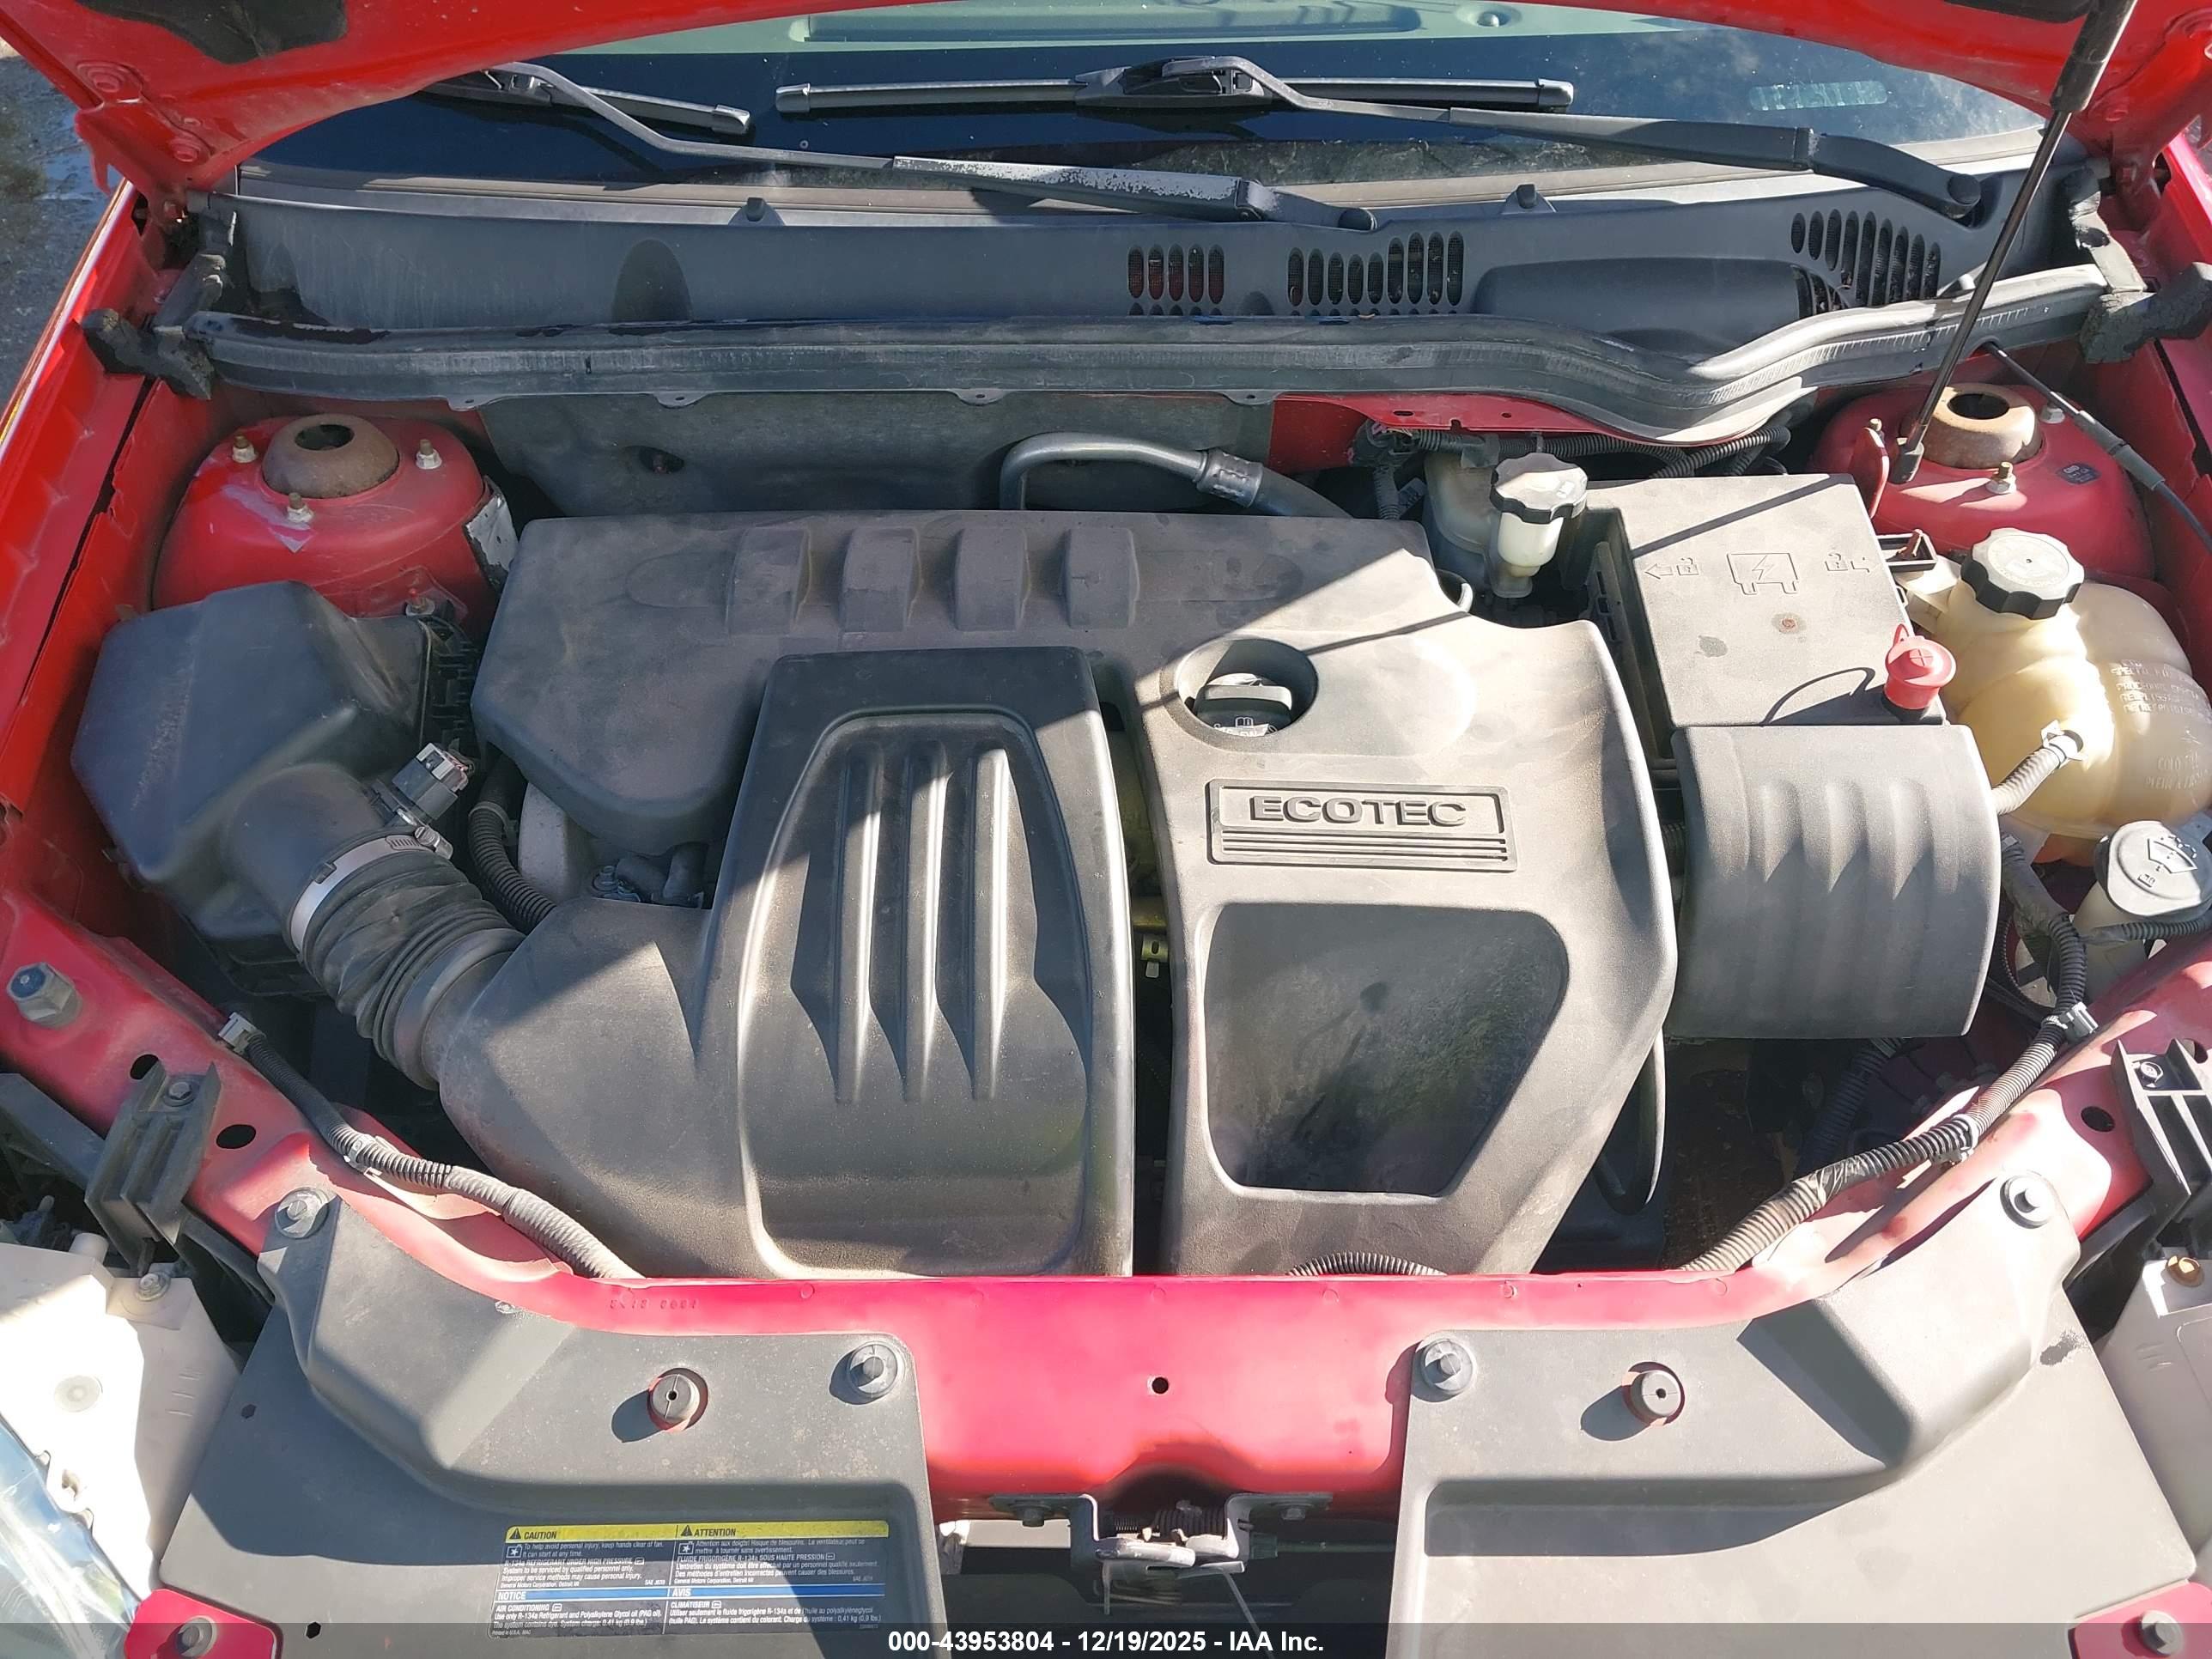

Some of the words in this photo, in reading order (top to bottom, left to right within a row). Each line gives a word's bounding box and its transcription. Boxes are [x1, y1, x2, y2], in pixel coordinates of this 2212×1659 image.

[1249, 795, 1468, 828] ECOTEC
[524, 1531, 557, 1540] CAUTION
[694, 1528, 737, 1537] ATTENTION
[560, 1542, 584, 1551] personal
[796, 1553, 824, 1561] PRESSION
[593, 1565, 621, 1573] personnel
[775, 1569, 797, 1577] peuvent
[501, 1575, 526, 1583] Improper
[497, 1590, 526, 1601] NOTICE
[672, 1588, 692, 1597] AVIS
[495, 1604, 507, 1613] AIR
[507, 1603, 550, 1612] CONDITIONING
[505, 1613, 517, 1621] only
[538, 1611, 568, 1620] Refrigerant
[580, 1610, 614, 1620] Polyalkylene
[613, 1610, 631, 1619] Glycol
[504, 1621, 525, 1630] system
[560, 1620, 580, 1628] System
[615, 1619, 624, 1627] kg
